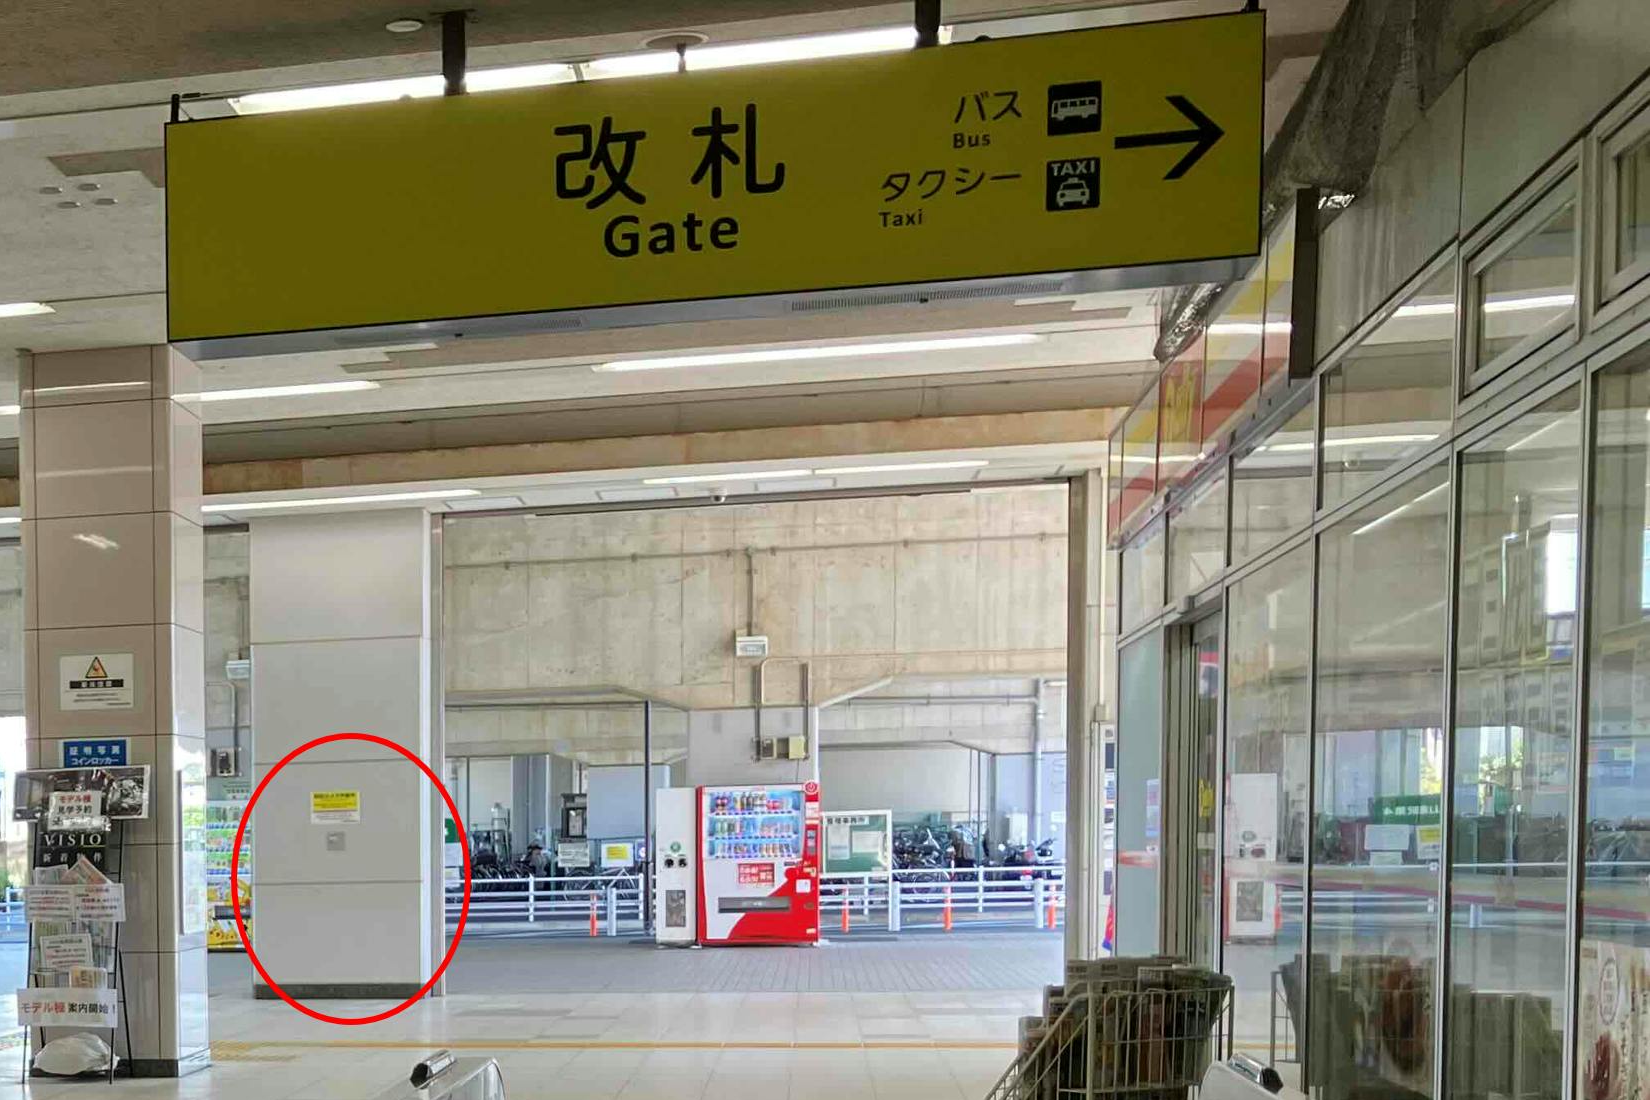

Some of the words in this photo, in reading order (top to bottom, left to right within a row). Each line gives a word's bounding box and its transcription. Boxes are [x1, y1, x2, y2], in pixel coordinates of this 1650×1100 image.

[952, 89, 1022, 125] バス
[952, 130, 991, 149] Bus
[555, 102, 785, 208] 改札
[1050, 159, 1097, 177] TAXI
[881, 164, 1022, 202] タクシー
[879, 207, 924, 229] Taxi
[603, 213, 739, 259] Gate
[71, 757, 119, 766] コインロッカー
